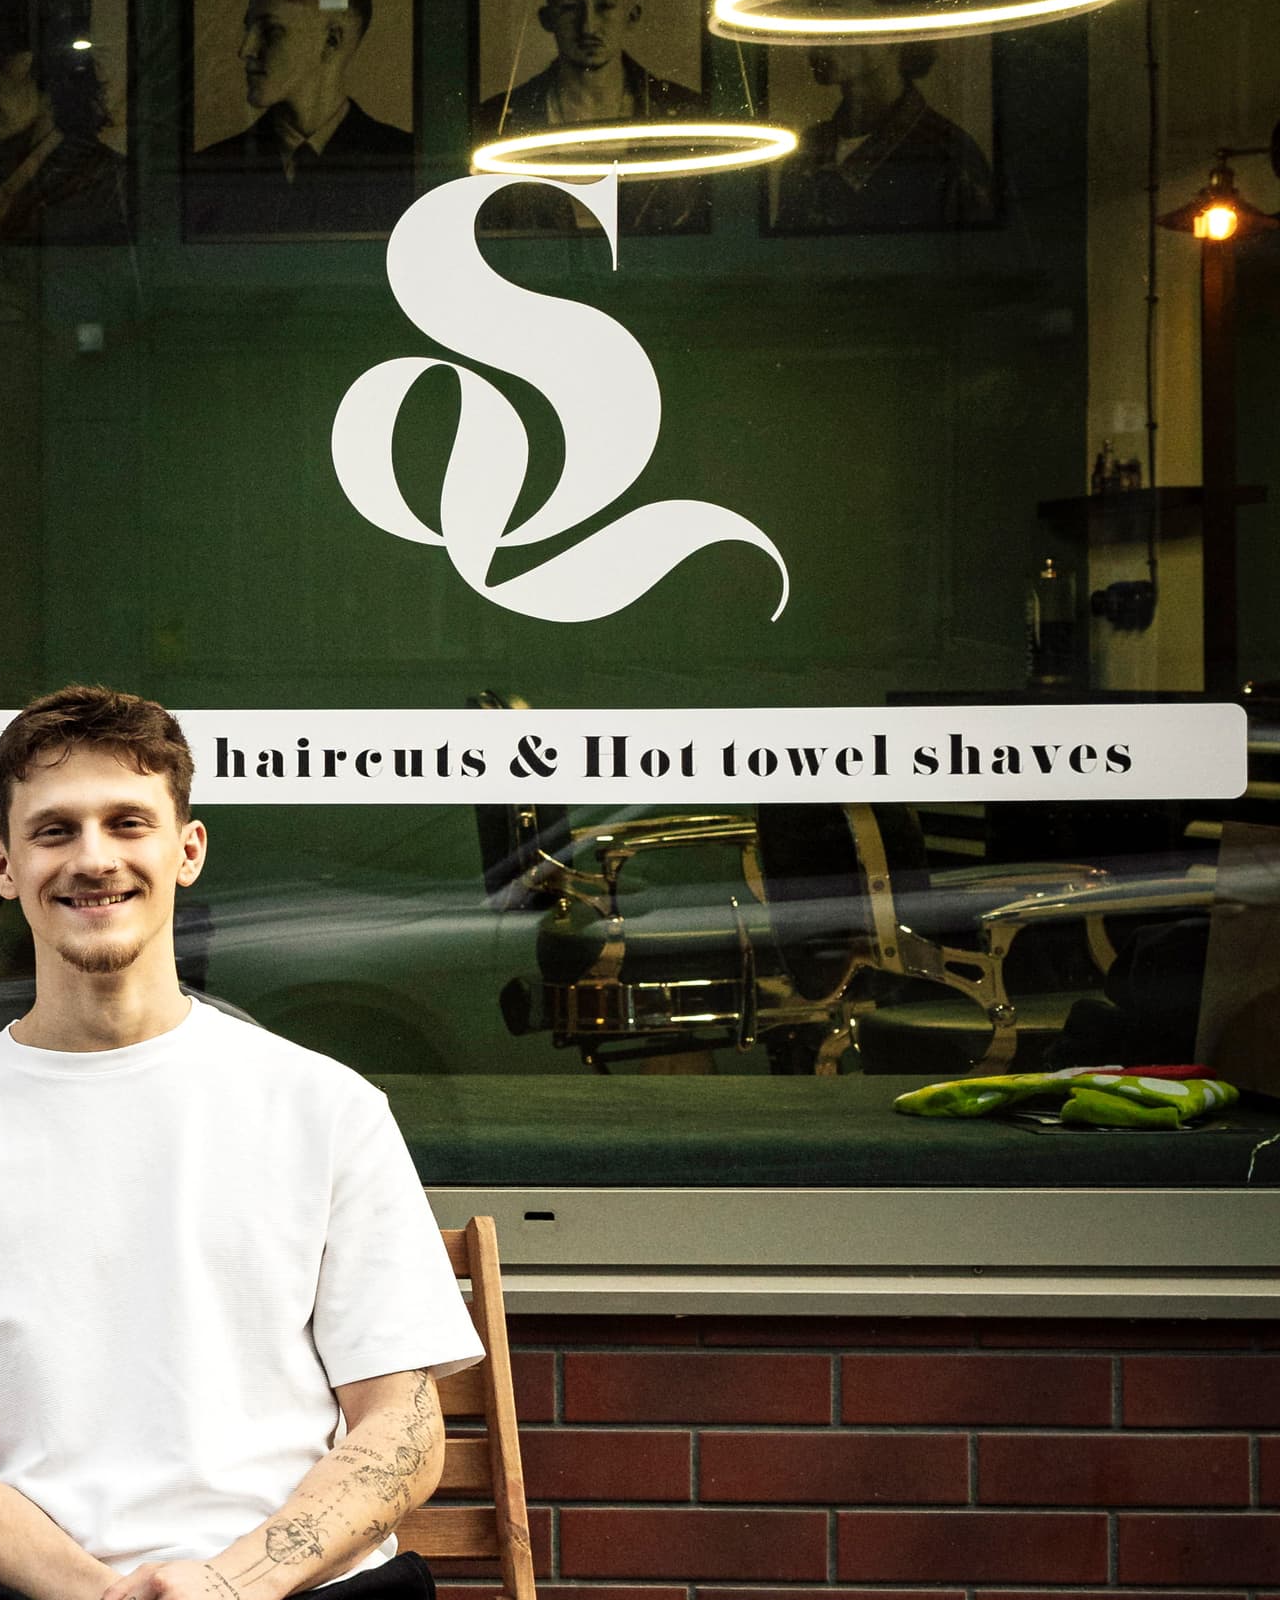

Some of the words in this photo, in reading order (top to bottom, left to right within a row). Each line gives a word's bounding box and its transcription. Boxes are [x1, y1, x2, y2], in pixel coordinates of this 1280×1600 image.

[214, 736, 488, 779] haircuts
[508, 734, 560, 779] &
[582, 735, 696, 778] Hot
[721, 734, 891, 777] towel
[912, 733, 1133, 776] shaves
